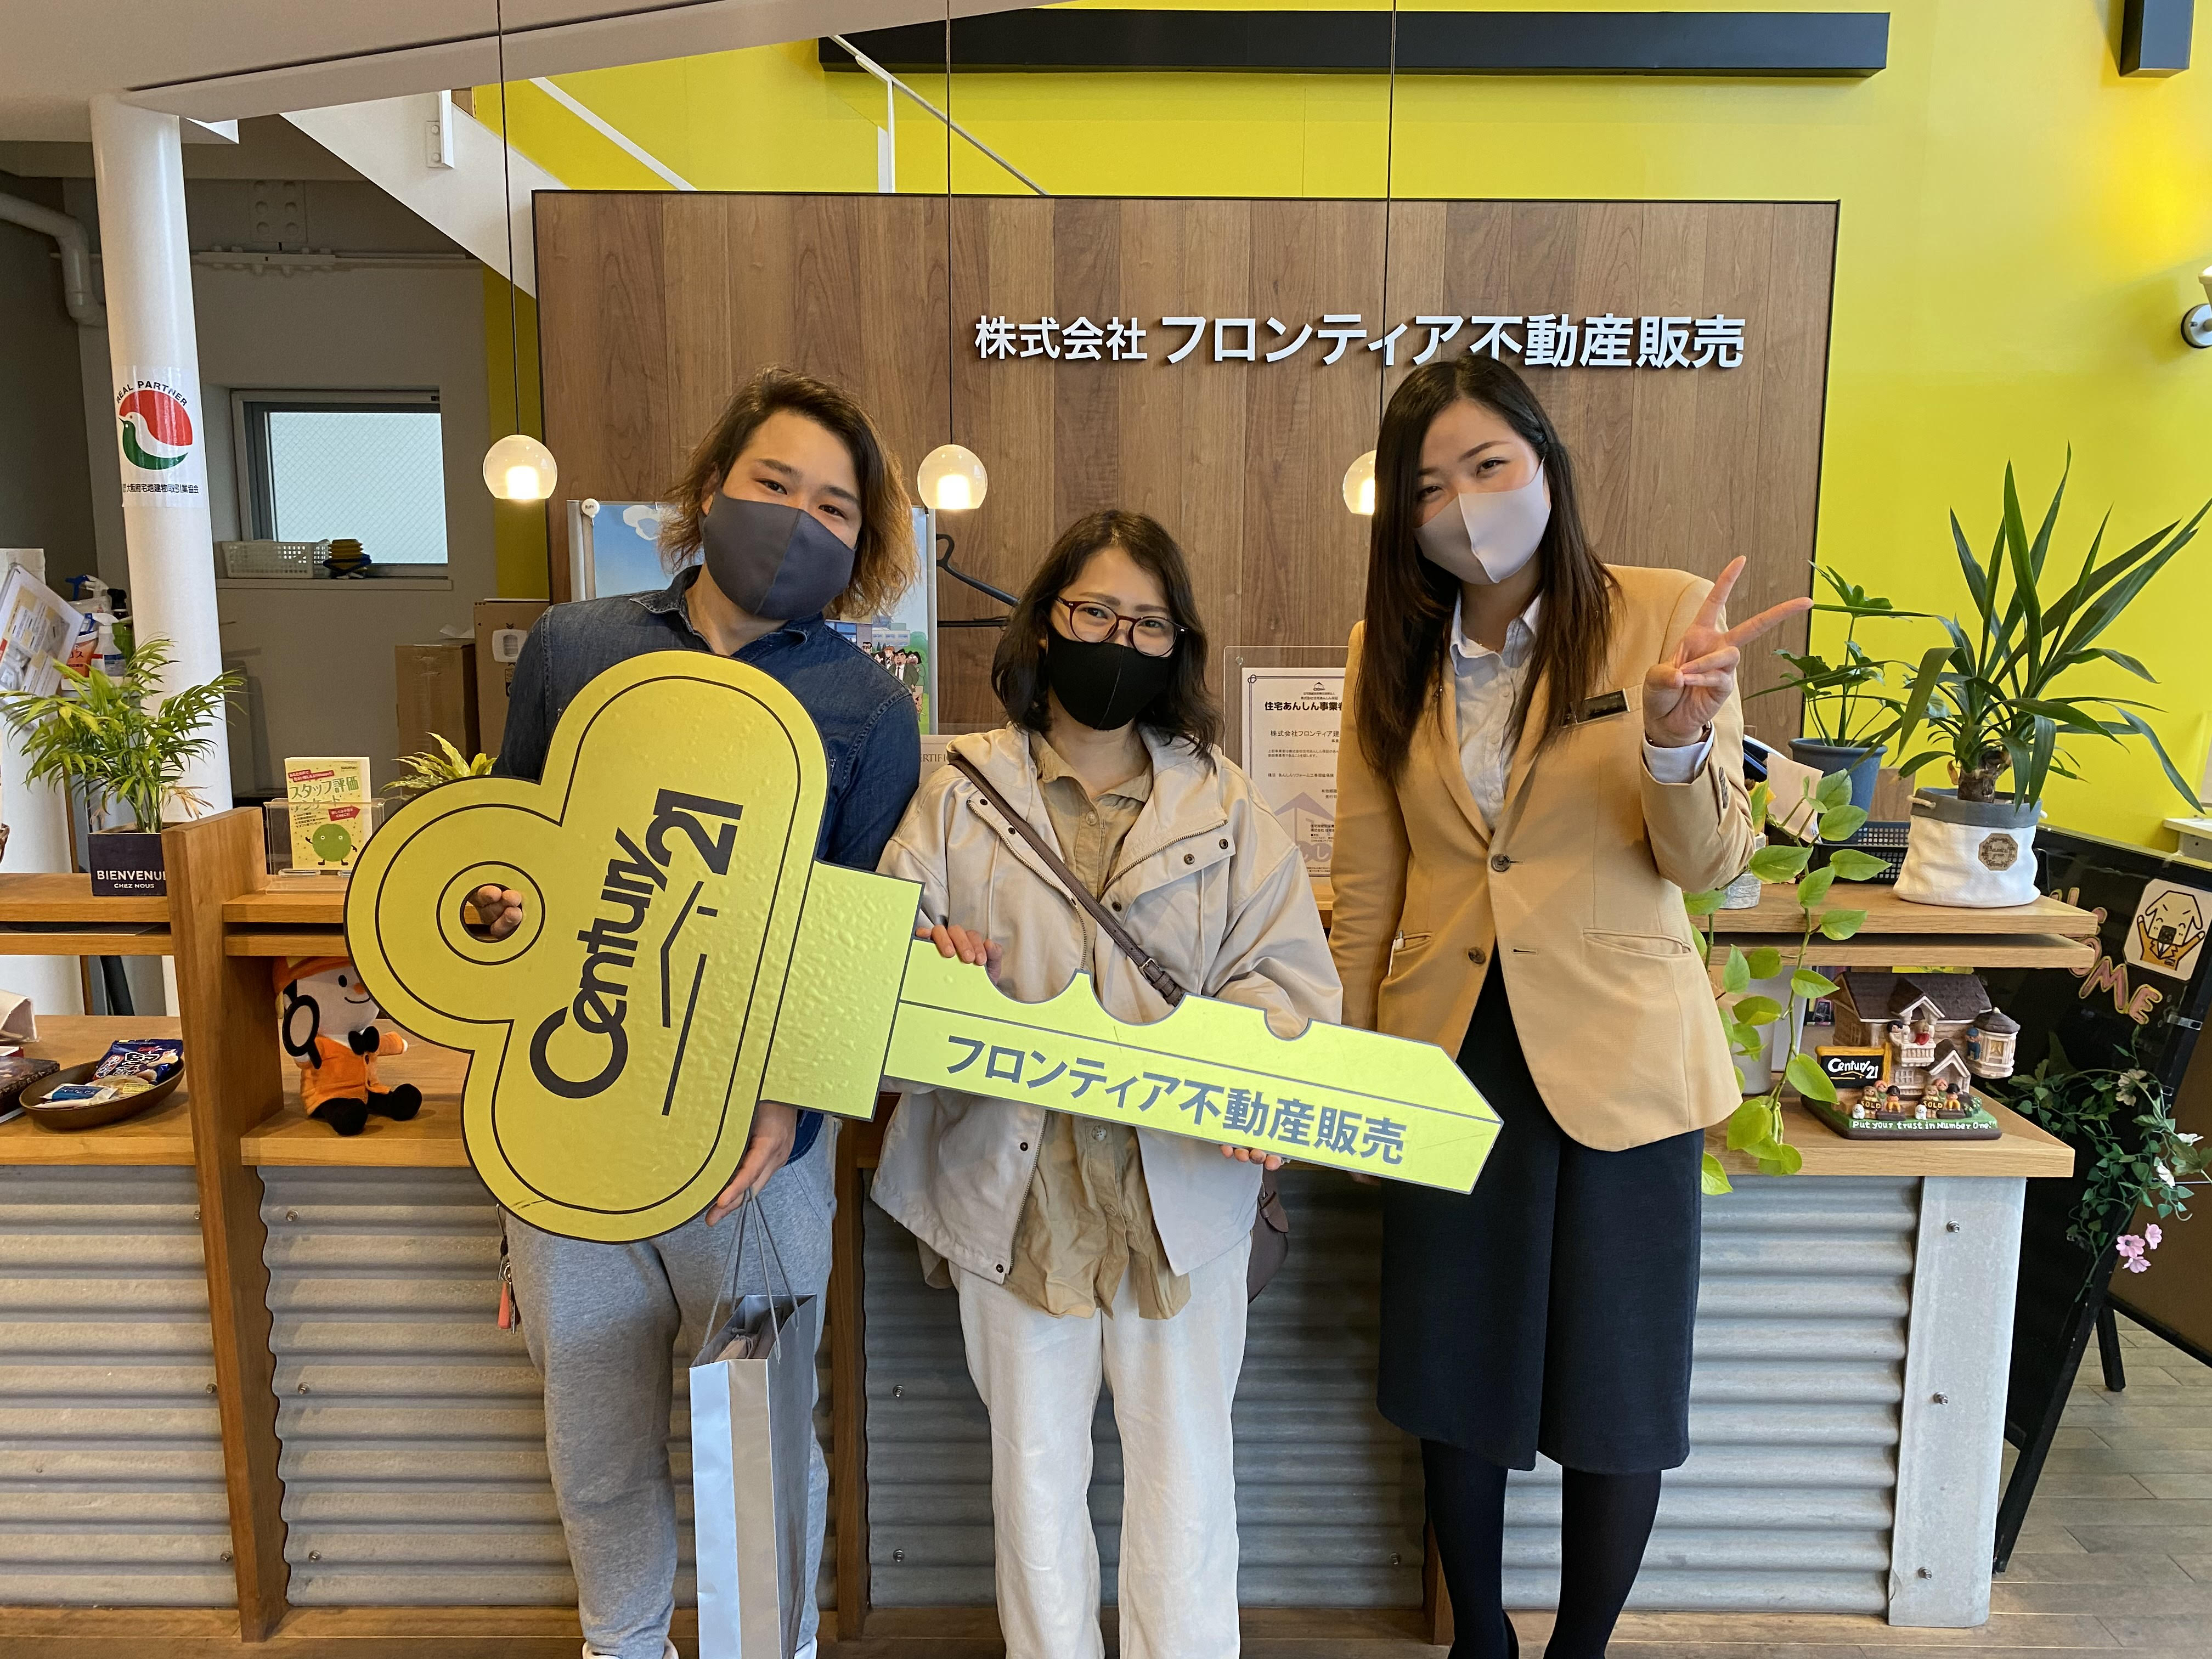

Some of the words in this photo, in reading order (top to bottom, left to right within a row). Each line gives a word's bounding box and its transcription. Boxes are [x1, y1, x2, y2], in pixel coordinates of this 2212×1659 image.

[975, 315, 1147, 361] 株式会社
[1162, 313, 1746, 369] フロンティア不動産販売
[116, 384, 133, 404] REAL
[138, 381, 187, 407] PARTNER
[920, 754, 946, 762] RTIFI
[289, 776, 359, 799] スタッフ評価
[529, 827, 668, 1099] Century
[645, 788, 743, 876] 21
[1827, 1058, 1871, 1073] Century
[1865, 1065, 1879, 1079] 21
[946, 1035, 1407, 1165] フロンティア不動産販売
[1860, 1101, 1882, 1109] SOLD
[1923, 1100, 1943, 1109] SOLD
[1872, 1121, 1893, 1130] your
[1897, 1121, 1922, 1130] trust
[1925, 1121, 1935, 1130] in
[1937, 1121, 1971, 1130] Number
